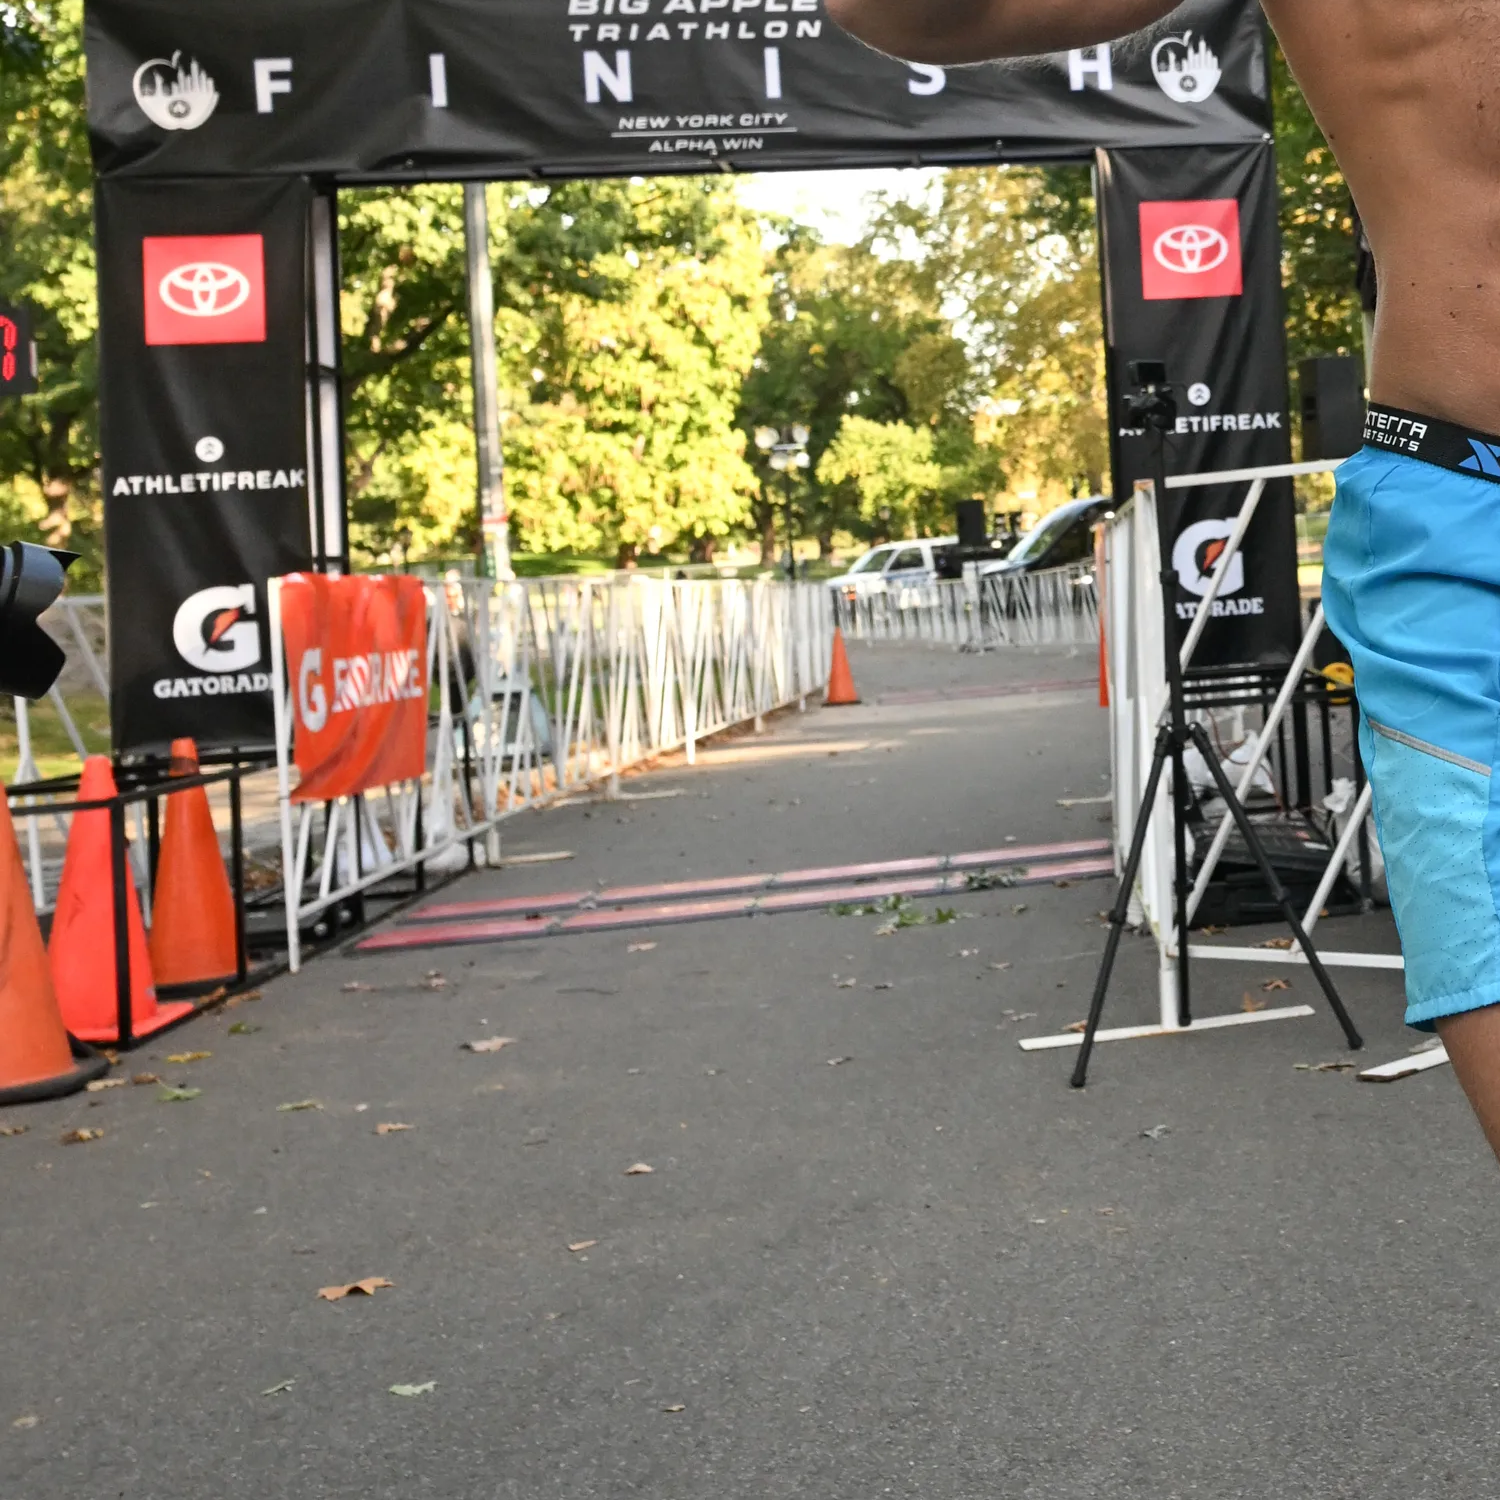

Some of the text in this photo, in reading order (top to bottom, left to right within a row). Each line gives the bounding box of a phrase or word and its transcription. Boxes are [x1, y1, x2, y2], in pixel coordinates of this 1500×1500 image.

[568, 19, 822, 43] TRIATHLON
[618, 111, 788, 130] NEW YORK CITY
[648, 136, 763, 153] ALPHA WIN
[112, 468, 306, 497] ATHLETIFREAK
